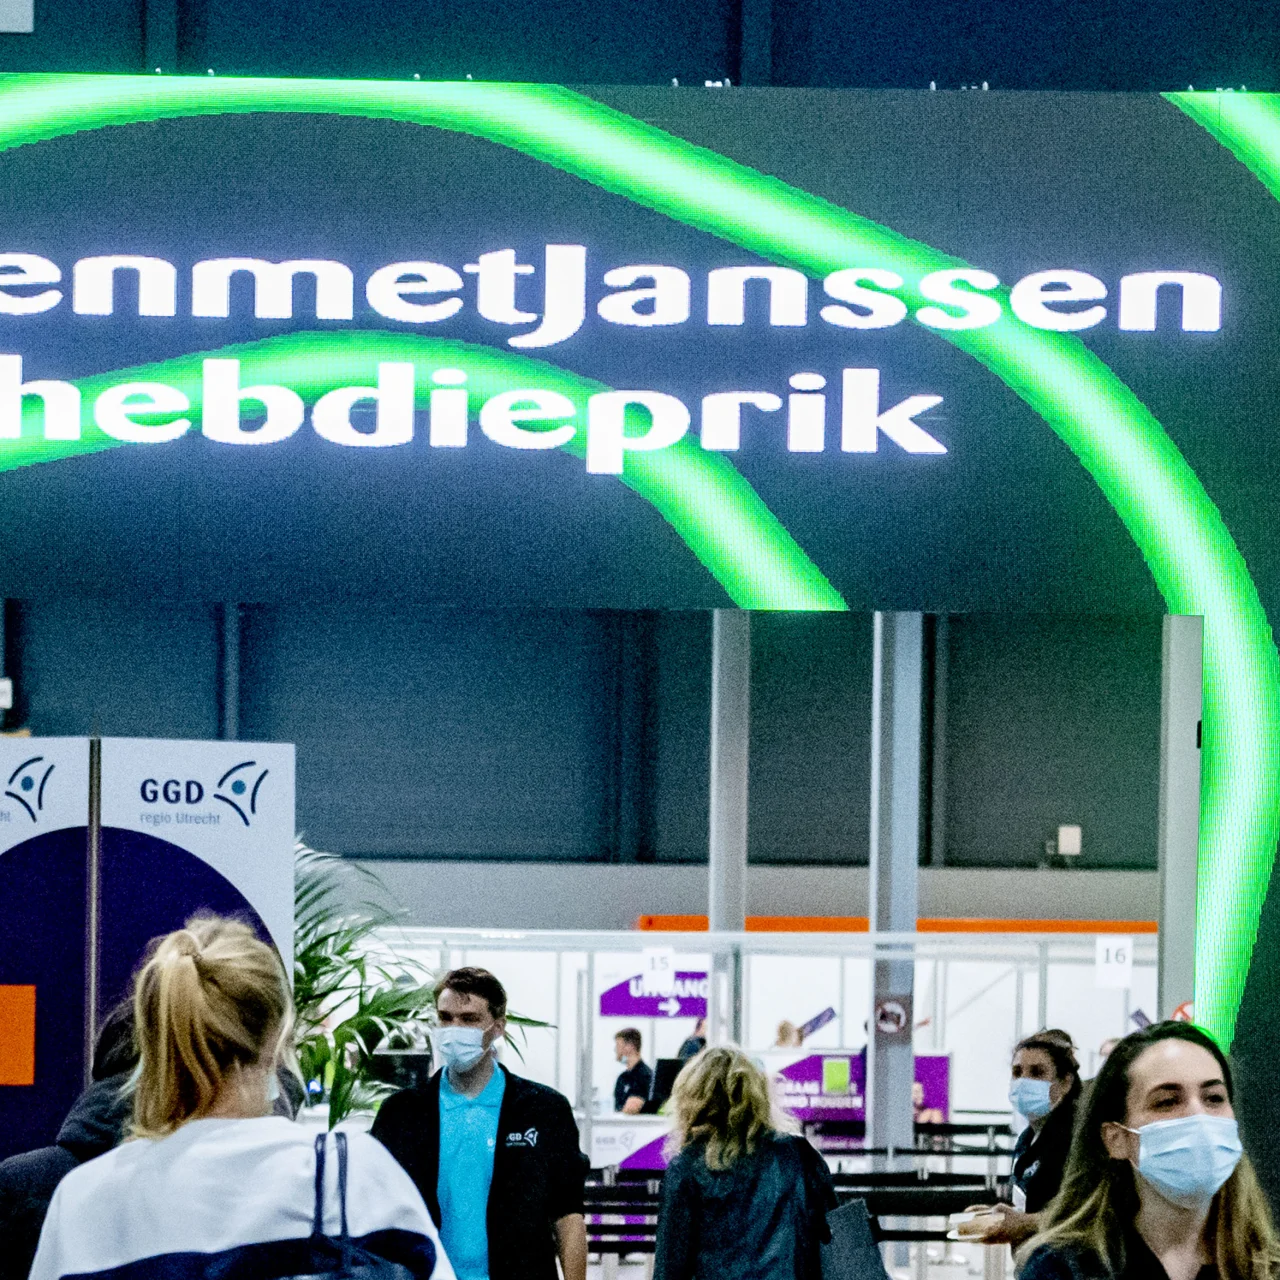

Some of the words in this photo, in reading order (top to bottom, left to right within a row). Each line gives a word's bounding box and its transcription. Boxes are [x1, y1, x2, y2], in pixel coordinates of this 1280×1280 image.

[140, 779, 205, 805] GGD
[140, 812, 172, 826] regio
[176, 813, 221, 825] Utrecht
[649, 955, 670, 971] 15
[1103, 947, 1126, 964] 16
